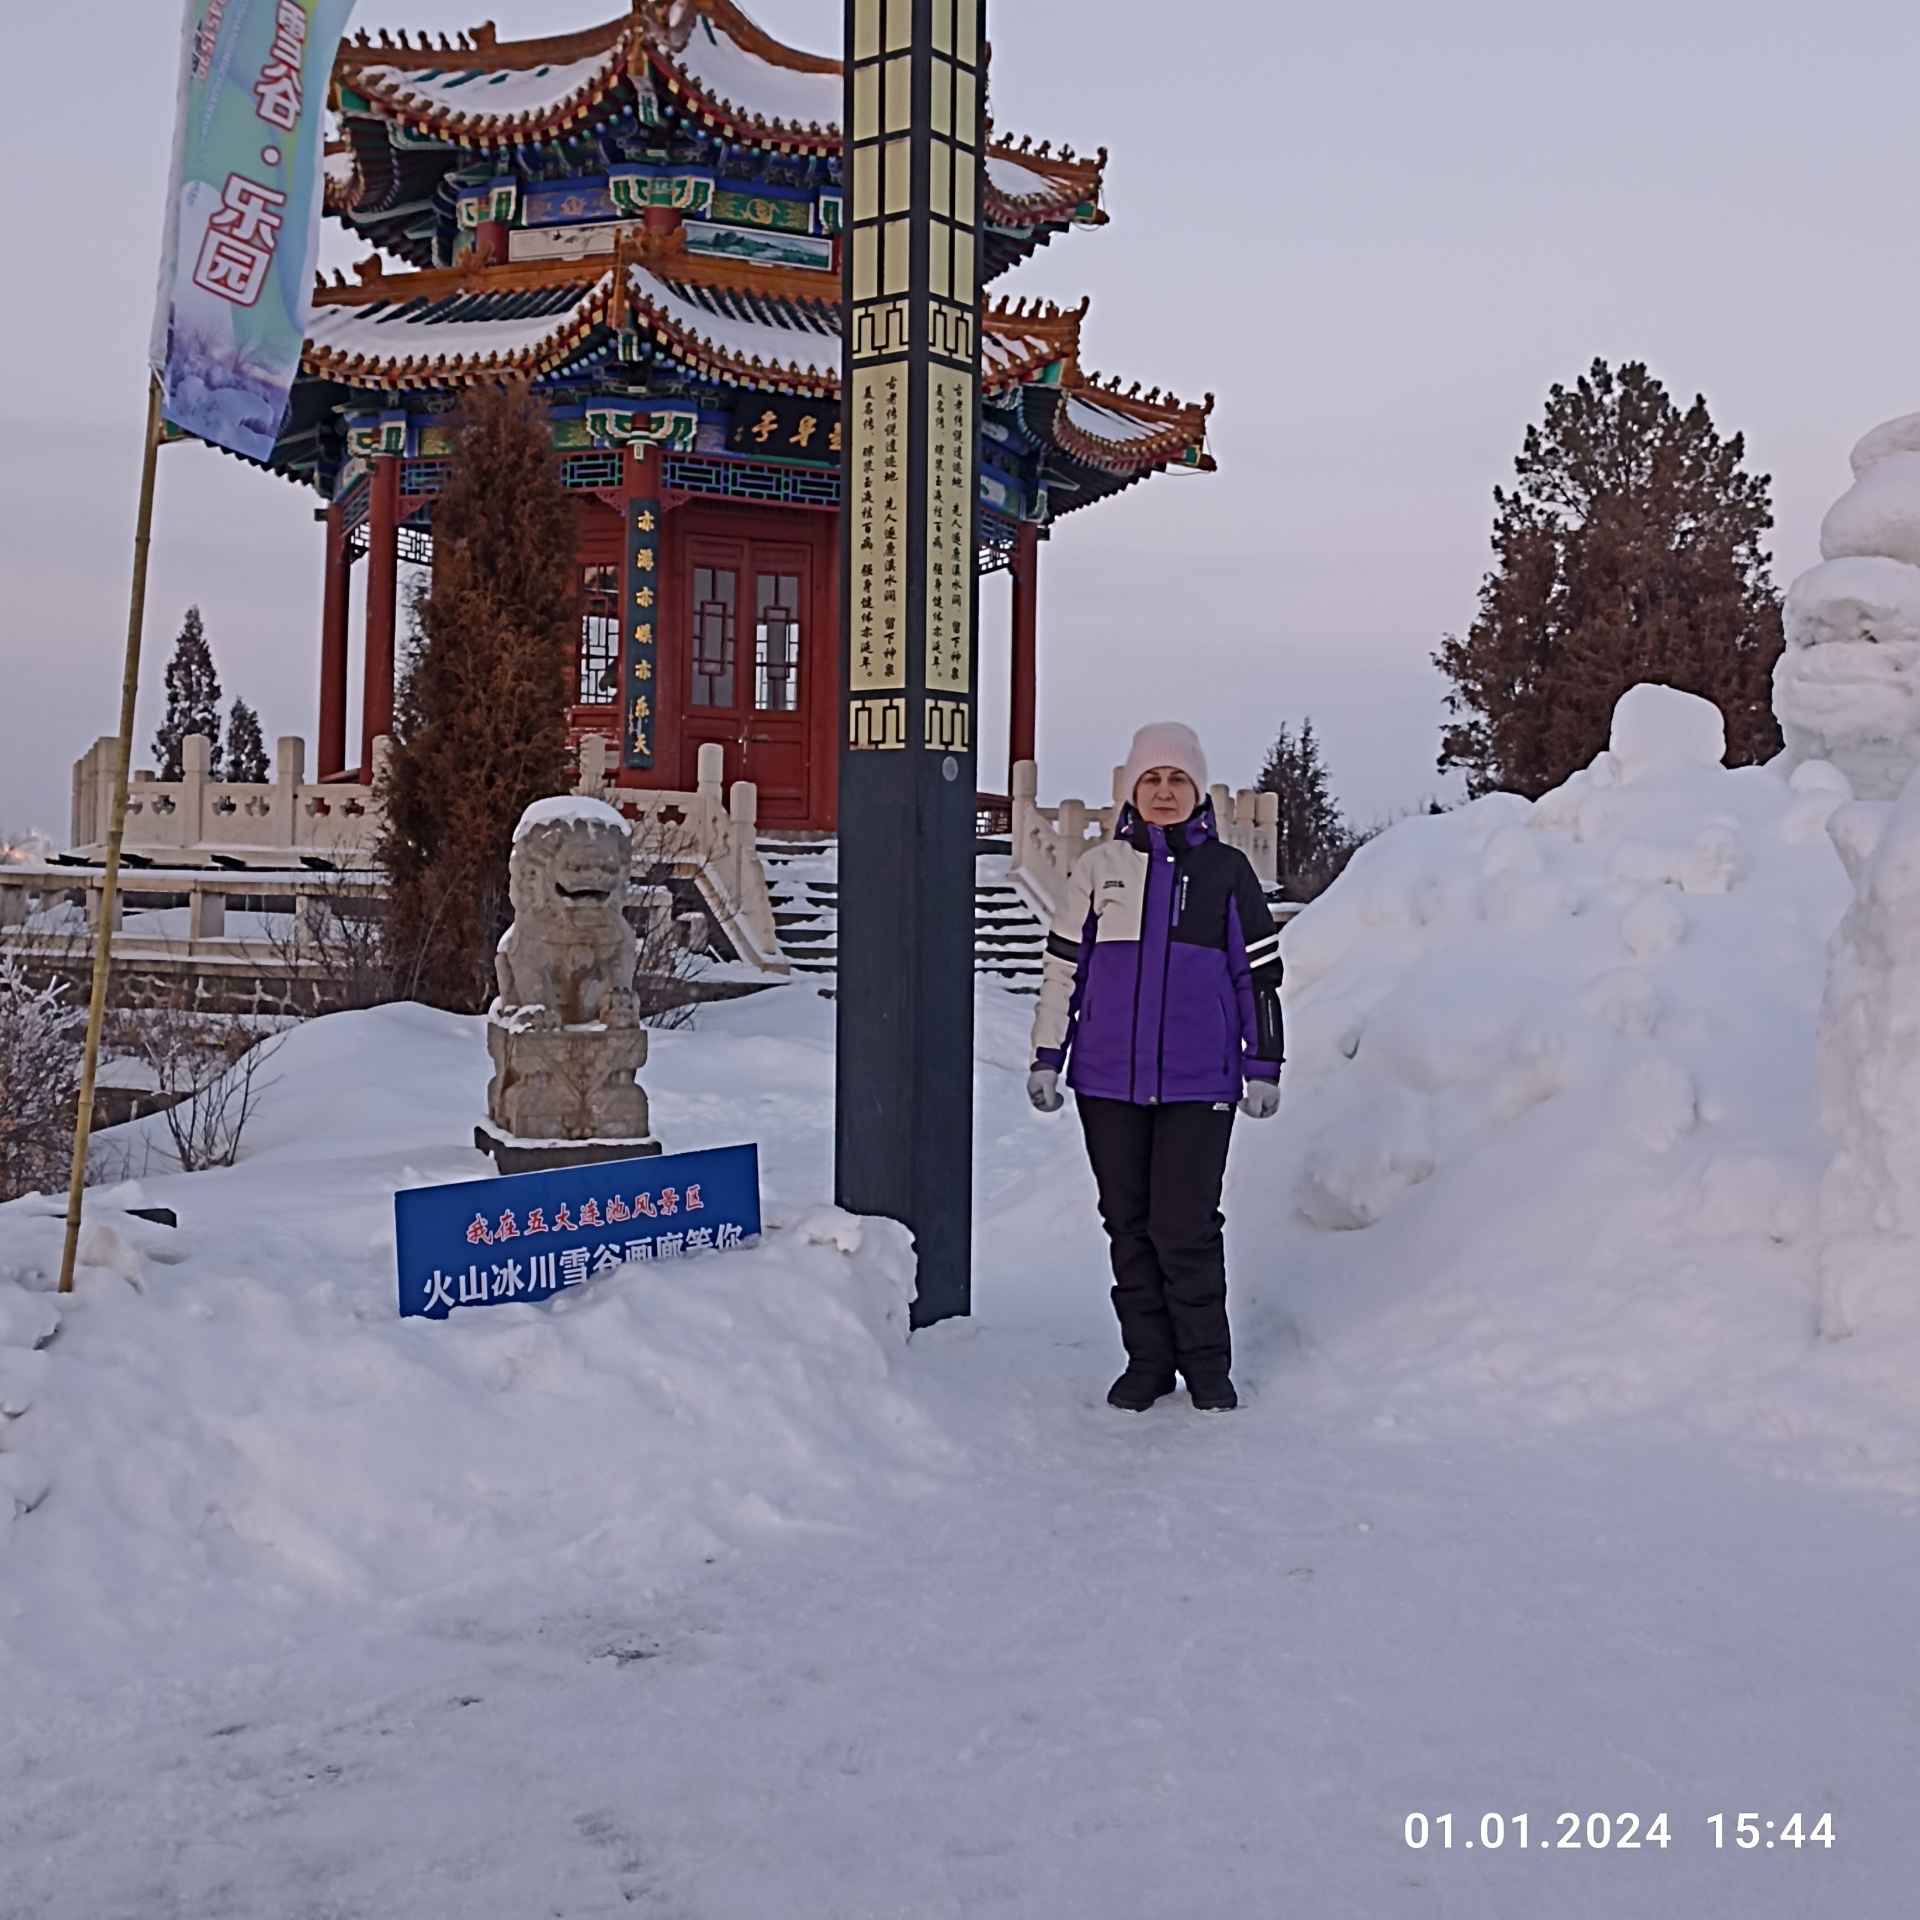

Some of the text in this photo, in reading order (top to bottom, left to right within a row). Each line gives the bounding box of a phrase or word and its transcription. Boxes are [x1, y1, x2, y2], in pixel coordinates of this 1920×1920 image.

[466, 1184, 704, 1245] 我在五大连池风景区
